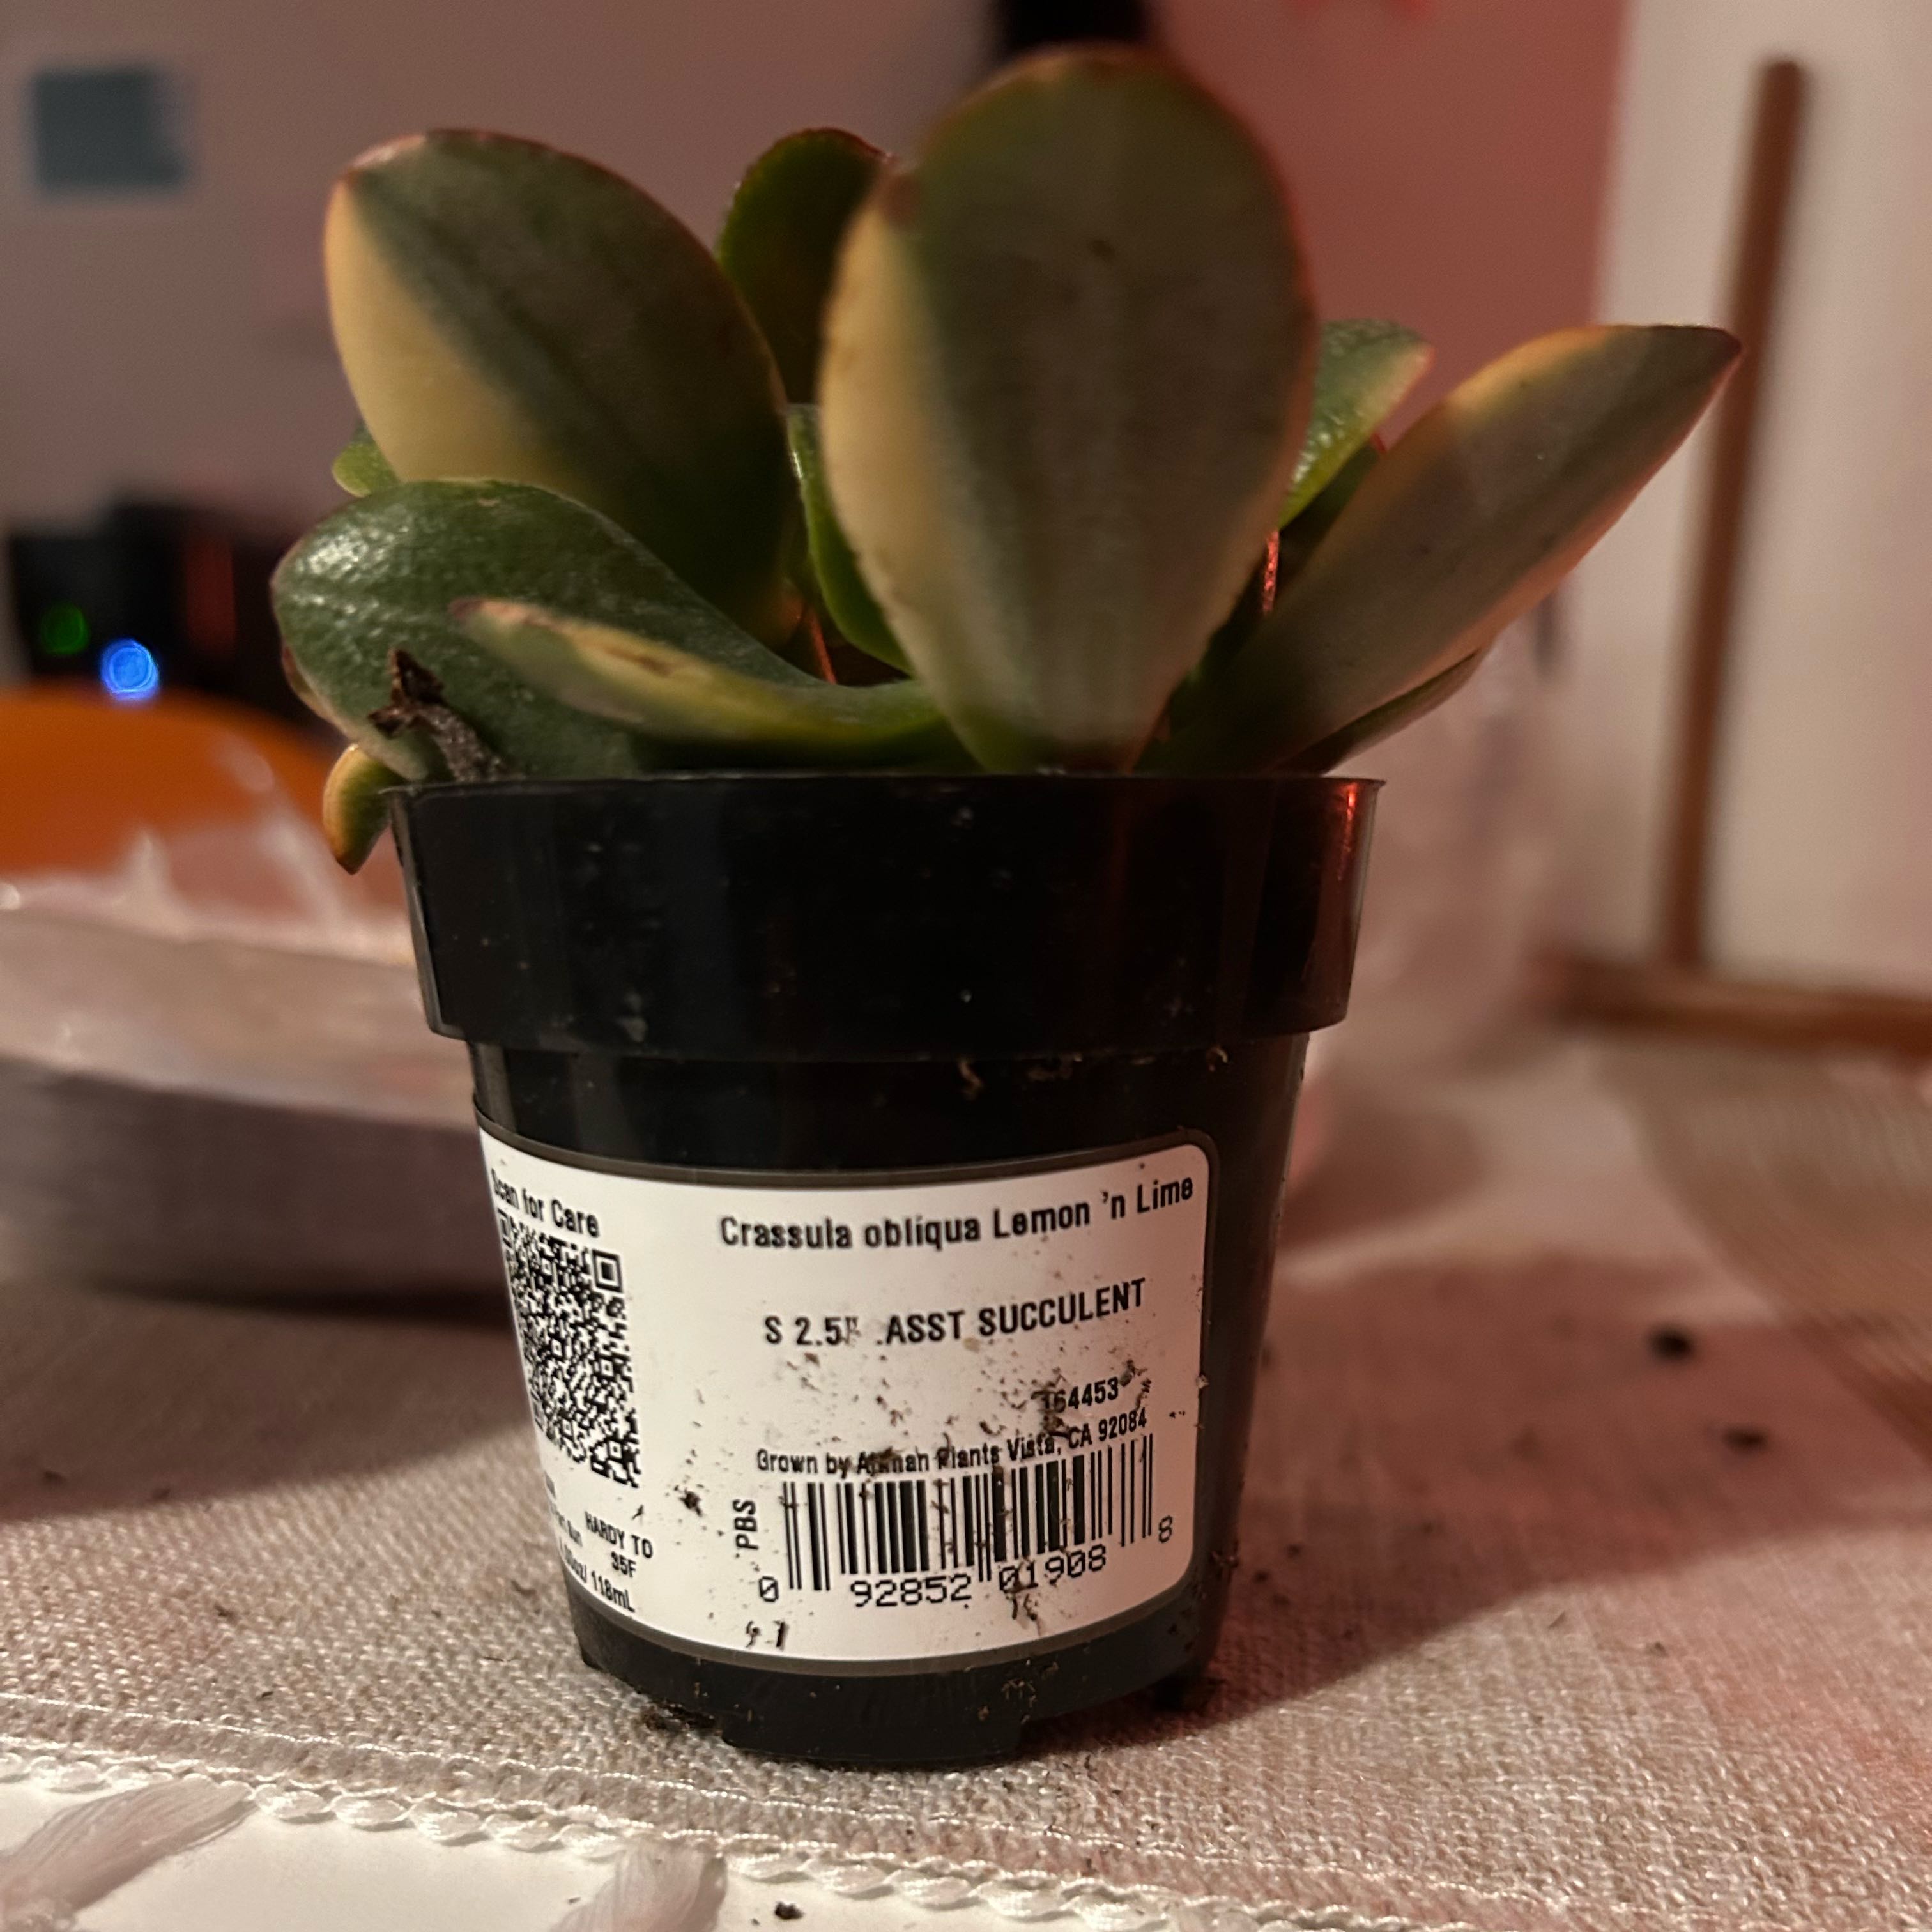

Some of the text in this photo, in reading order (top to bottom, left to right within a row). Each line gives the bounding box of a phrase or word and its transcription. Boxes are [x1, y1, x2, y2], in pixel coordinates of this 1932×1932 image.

[522, 1188, 544, 1222] for
[551, 1198, 600, 1238] Care
[721, 1216, 853, 1248] Crassula
[864, 1215, 981, 1251] obliqua
[993, 1202, 1091, 1239] Lemon
[1137, 1177, 1193, 1213] Lime
[765, 1315, 783, 1344] S
[886, 1310, 965, 1345] ASST
[979, 1277, 1146, 1337] SUCCULENT
[756, 1448, 818, 1474] Grown
[826, 1452, 853, 1479] by
[937, 1443, 1001, 1469] Plants
[1068, 1424, 1093, 1450] CA
[1098, 1407, 1147, 1442] 92084
[585, 1510, 625, 1550] HARDY
[631, 1534, 654, 1559] TO
[733, 1499, 759, 1550] PBS
[611, 1551, 637, 1579] 35F
[758, 1515, 1174, 1607] 0 92852 01908 8
[591, 1570, 636, 1613] 118mL
